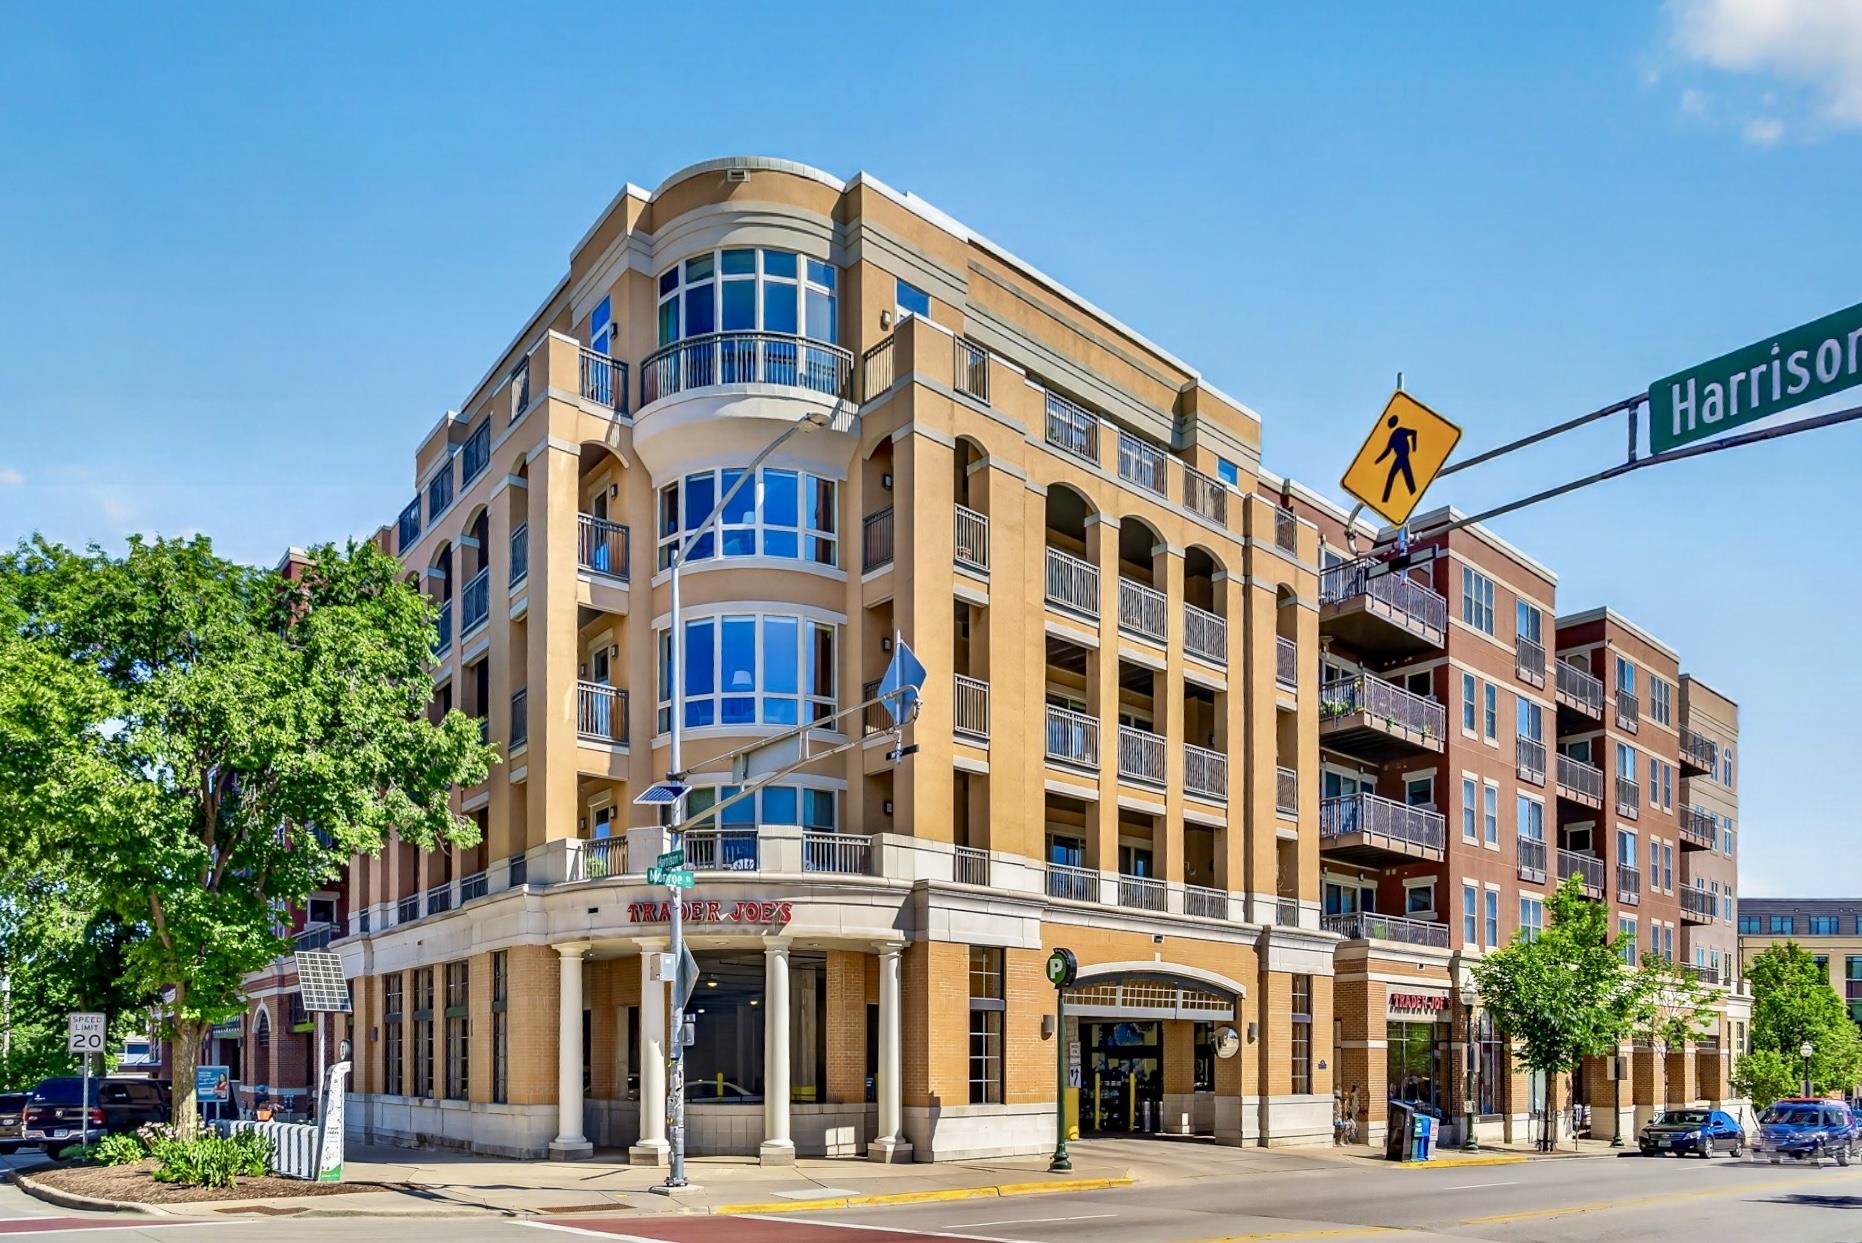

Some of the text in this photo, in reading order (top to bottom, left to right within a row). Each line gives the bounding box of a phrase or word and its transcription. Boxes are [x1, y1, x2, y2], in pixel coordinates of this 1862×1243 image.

[649, 869, 682, 885] Monroe
[729, 901, 793, 924] JOE'S
[1049, 958, 1063, 979] P
[1393, 994, 1428, 1009] TRADER
[73, 1034, 101, 1048] 20
